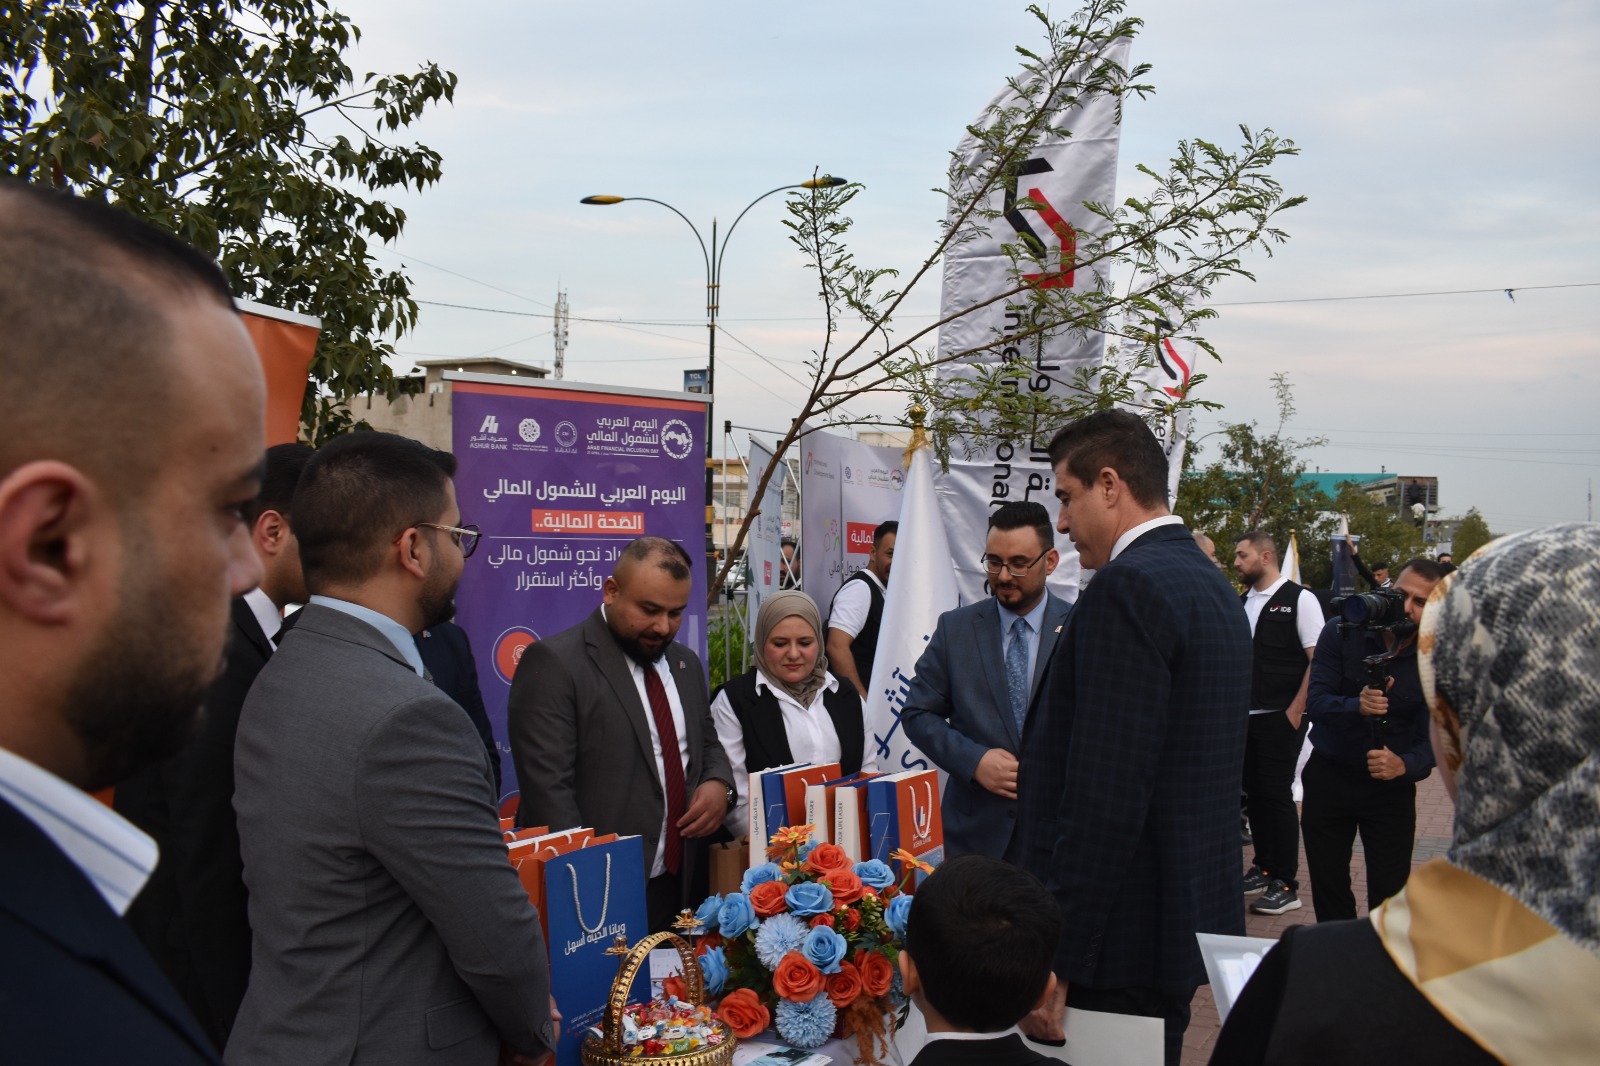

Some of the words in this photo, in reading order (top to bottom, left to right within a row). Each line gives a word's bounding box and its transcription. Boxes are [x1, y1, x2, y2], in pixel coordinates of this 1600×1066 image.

[596, 416, 629, 430] العربي
[632, 418, 658, 432] اليوم
[469, 442, 490, 450] ASHUR
[490, 443, 508, 451] BANK
[586, 430, 618, 444] المالي
[621, 432, 659, 447] للشمول
[600, 445, 625, 453] FINANCIAL
[483, 478, 532, 503] المالي
[536, 480, 597, 501] للشمول
[600, 485, 647, 507] العربي
[650, 486, 686, 505] اليوم
[488, 544, 523, 569] مالي
[526, 544, 572, 565] شمول
[576, 546, 600, 565] نحو
[515, 571, 564, 591] استقرار
[567, 566, 603, 591] وأكثر
[564, 930, 586, 956] أسهل
